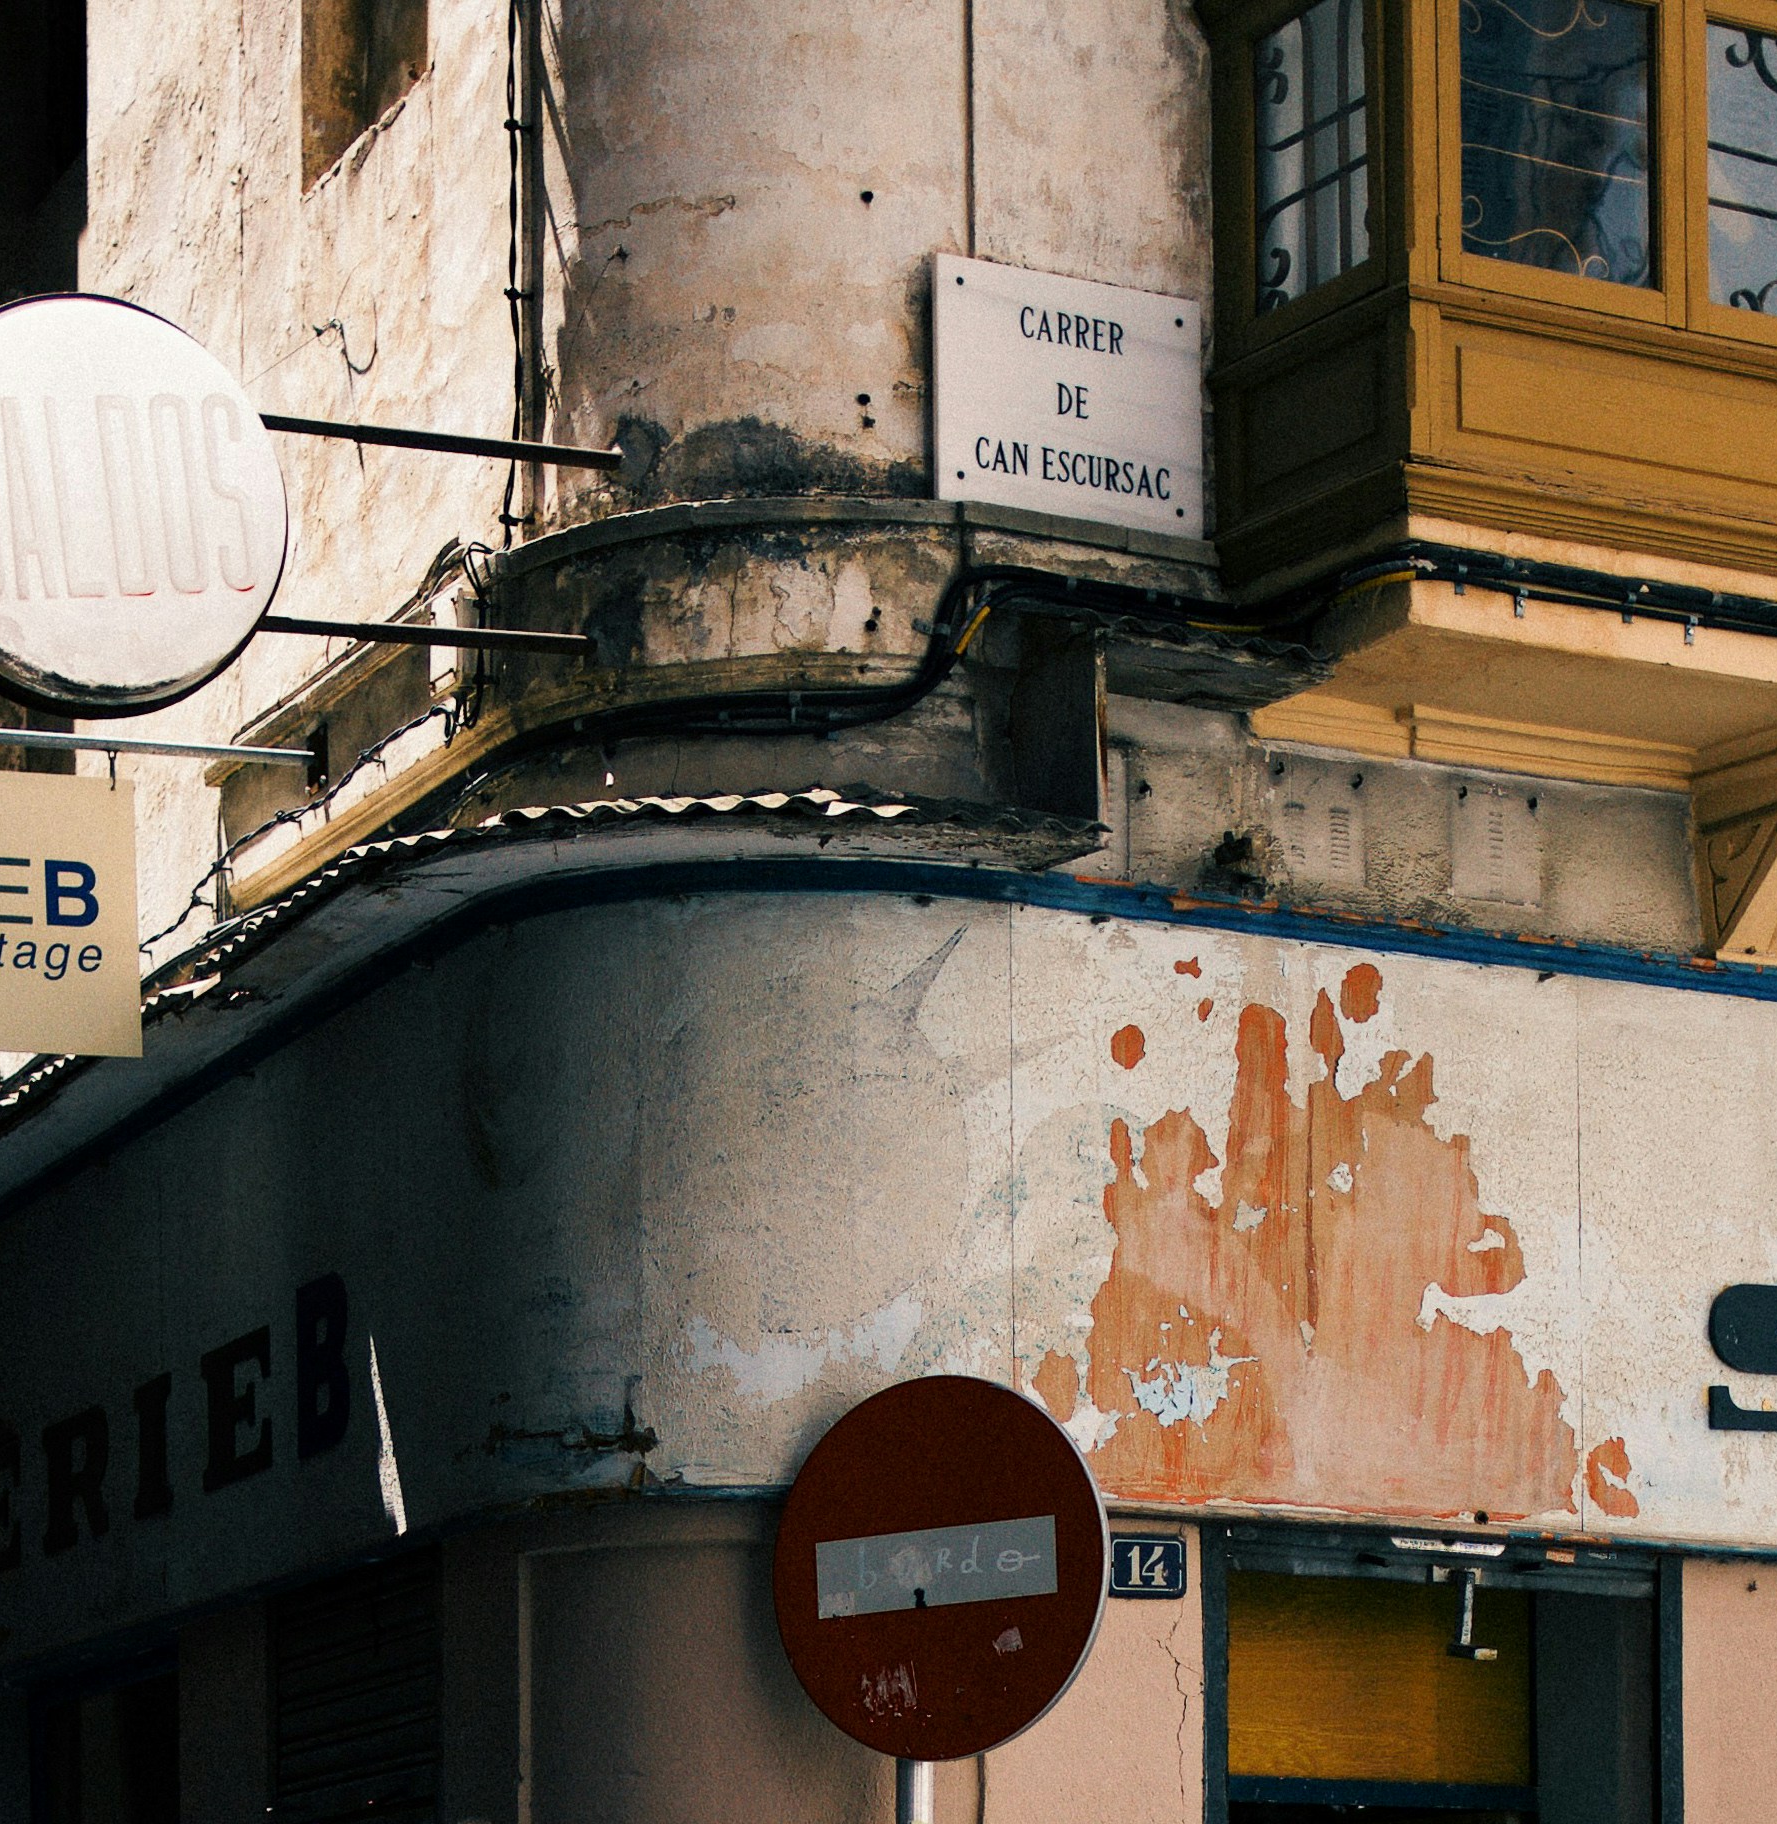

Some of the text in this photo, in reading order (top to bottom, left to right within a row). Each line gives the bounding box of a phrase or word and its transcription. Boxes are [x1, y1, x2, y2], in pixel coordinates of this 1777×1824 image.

[1020, 306, 1124, 355] CARRER
[1056, 382, 1089, 419] DE
[975, 436, 1170, 500] CAN ESCURSAC
[1127, 1544, 1167, 1587] 14
